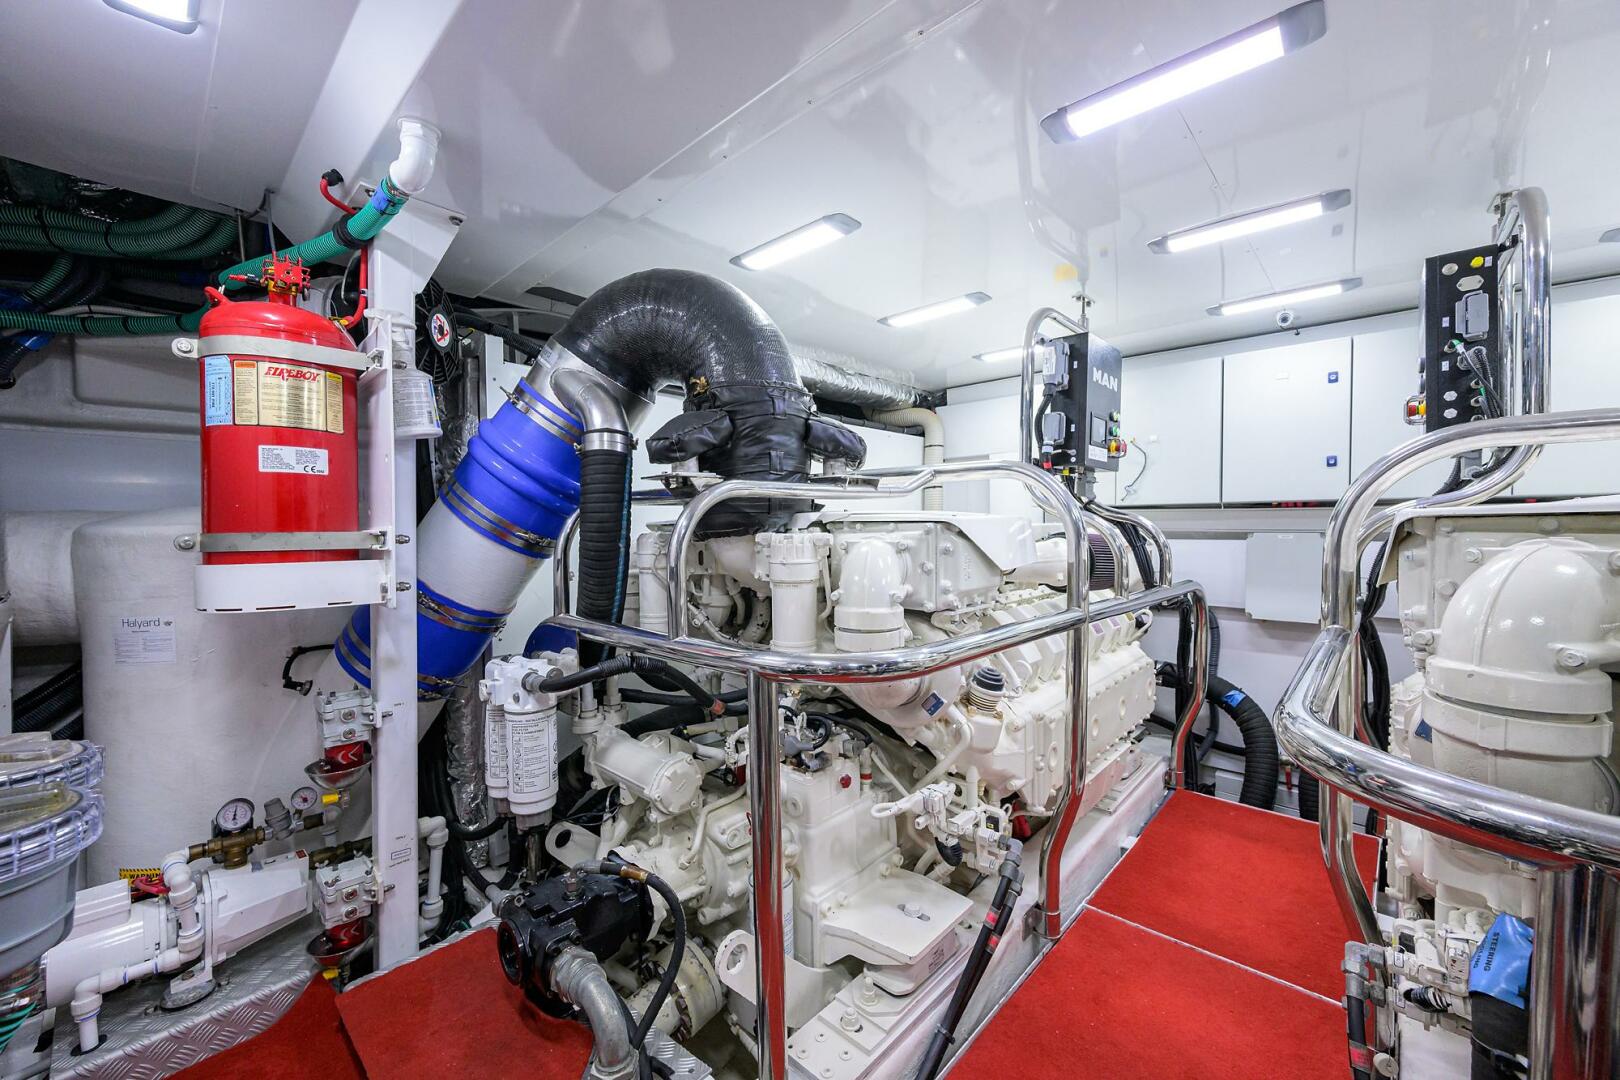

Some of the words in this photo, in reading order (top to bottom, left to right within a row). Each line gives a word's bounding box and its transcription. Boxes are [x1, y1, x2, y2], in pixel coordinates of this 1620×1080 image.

[264, 366, 320, 382] FIREBOY
[1093, 366, 1118, 392] MAN
[121, 618, 160, 629] Halyard
[1483, 932, 1499, 972] STEERING
